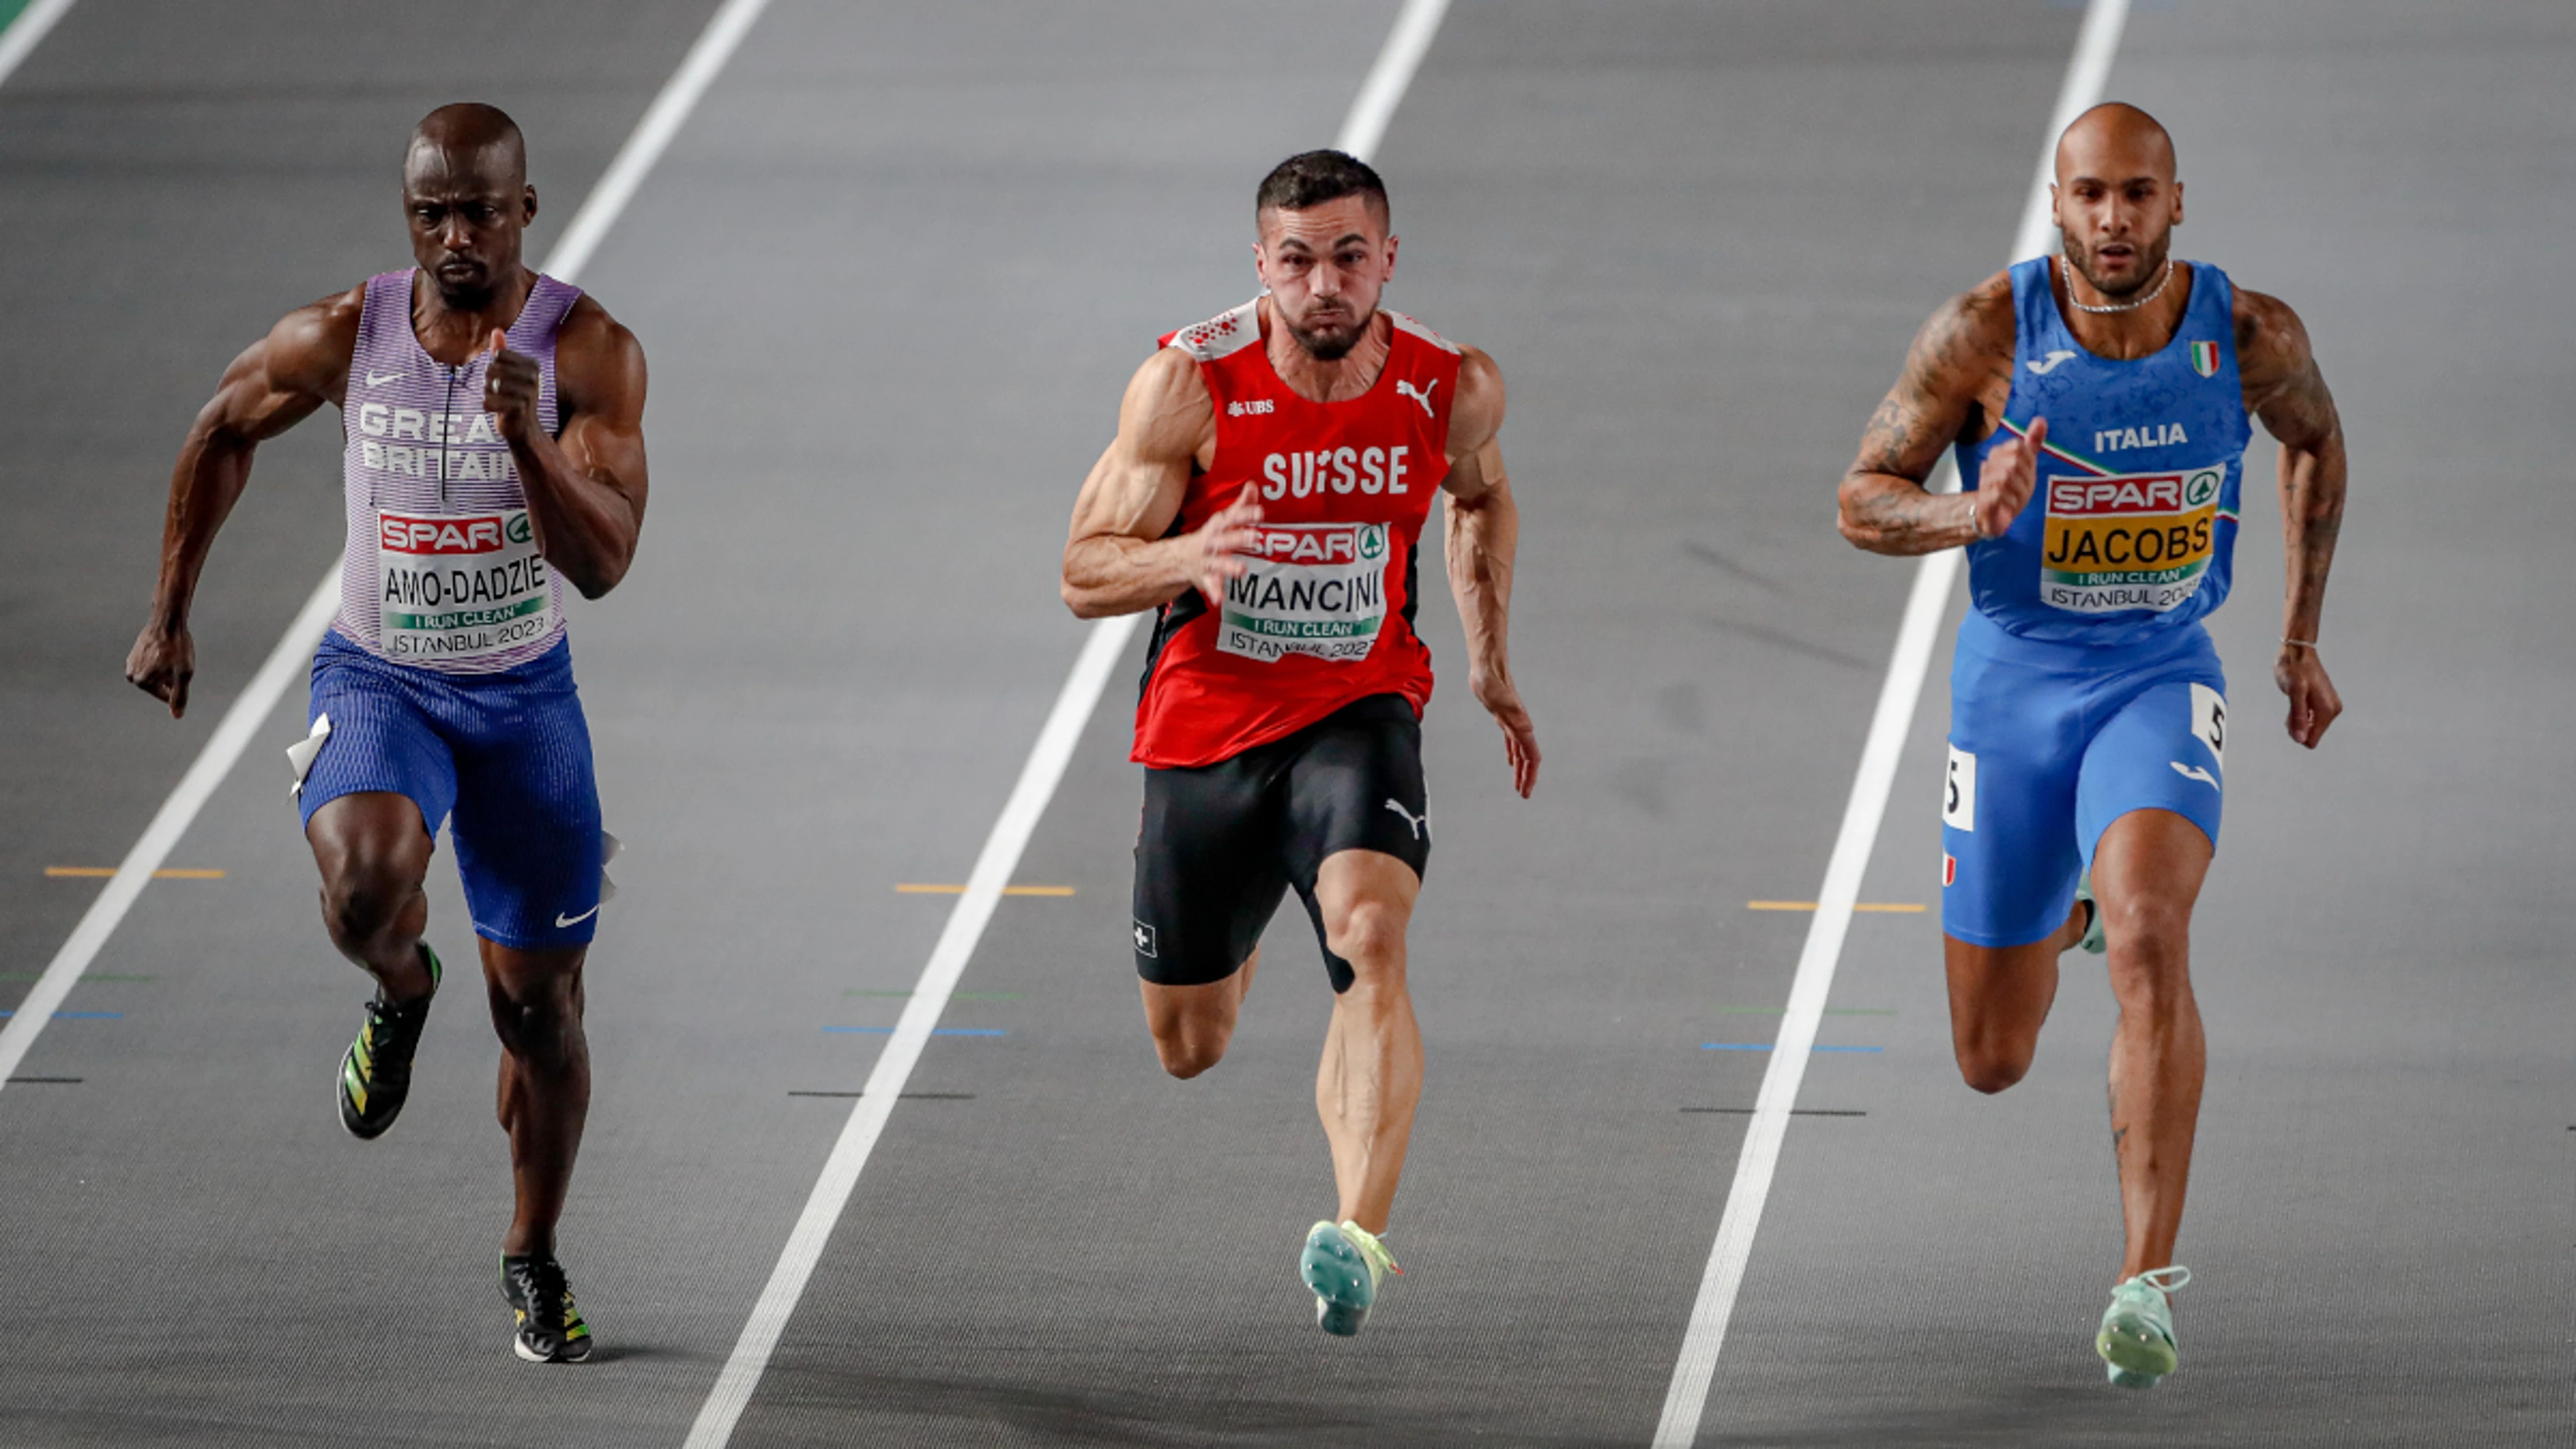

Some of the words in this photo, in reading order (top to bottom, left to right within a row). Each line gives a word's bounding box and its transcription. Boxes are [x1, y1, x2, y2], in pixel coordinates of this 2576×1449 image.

[360, 402, 499, 443] GREA
[1246, 399, 1275, 415] UBS
[2094, 423, 2188, 453] ITALIA
[2053, 480, 2180, 511] SPAR
[382, 519, 501, 550] SPAR
[2048, 517, 2208, 564] JACOBS
[385, 553, 546, 606] AMO-DADZIE
[1228, 568, 1379, 612] MANCINI
[2080, 575, 2083, 585] I
[2088, 573, 2123, 585] RUN
[2127, 568, 2180, 584] CLEAN
[2051, 587, 2154, 606] ISTANBUL
[416, 616, 420, 628] I
[424, 615, 459, 628] RUN
[463, 606, 515, 624] CLEAN
[1254, 621, 1259, 632] I
[1263, 620, 1298, 636] RUN
[1302, 624, 1353, 637] CLEAN
[393, 631, 494, 653] ISTANBUL
[498, 616, 544, 644] 2023
[2209, 703, 2224, 752] 5
[1947, 760, 1960, 814] 5
